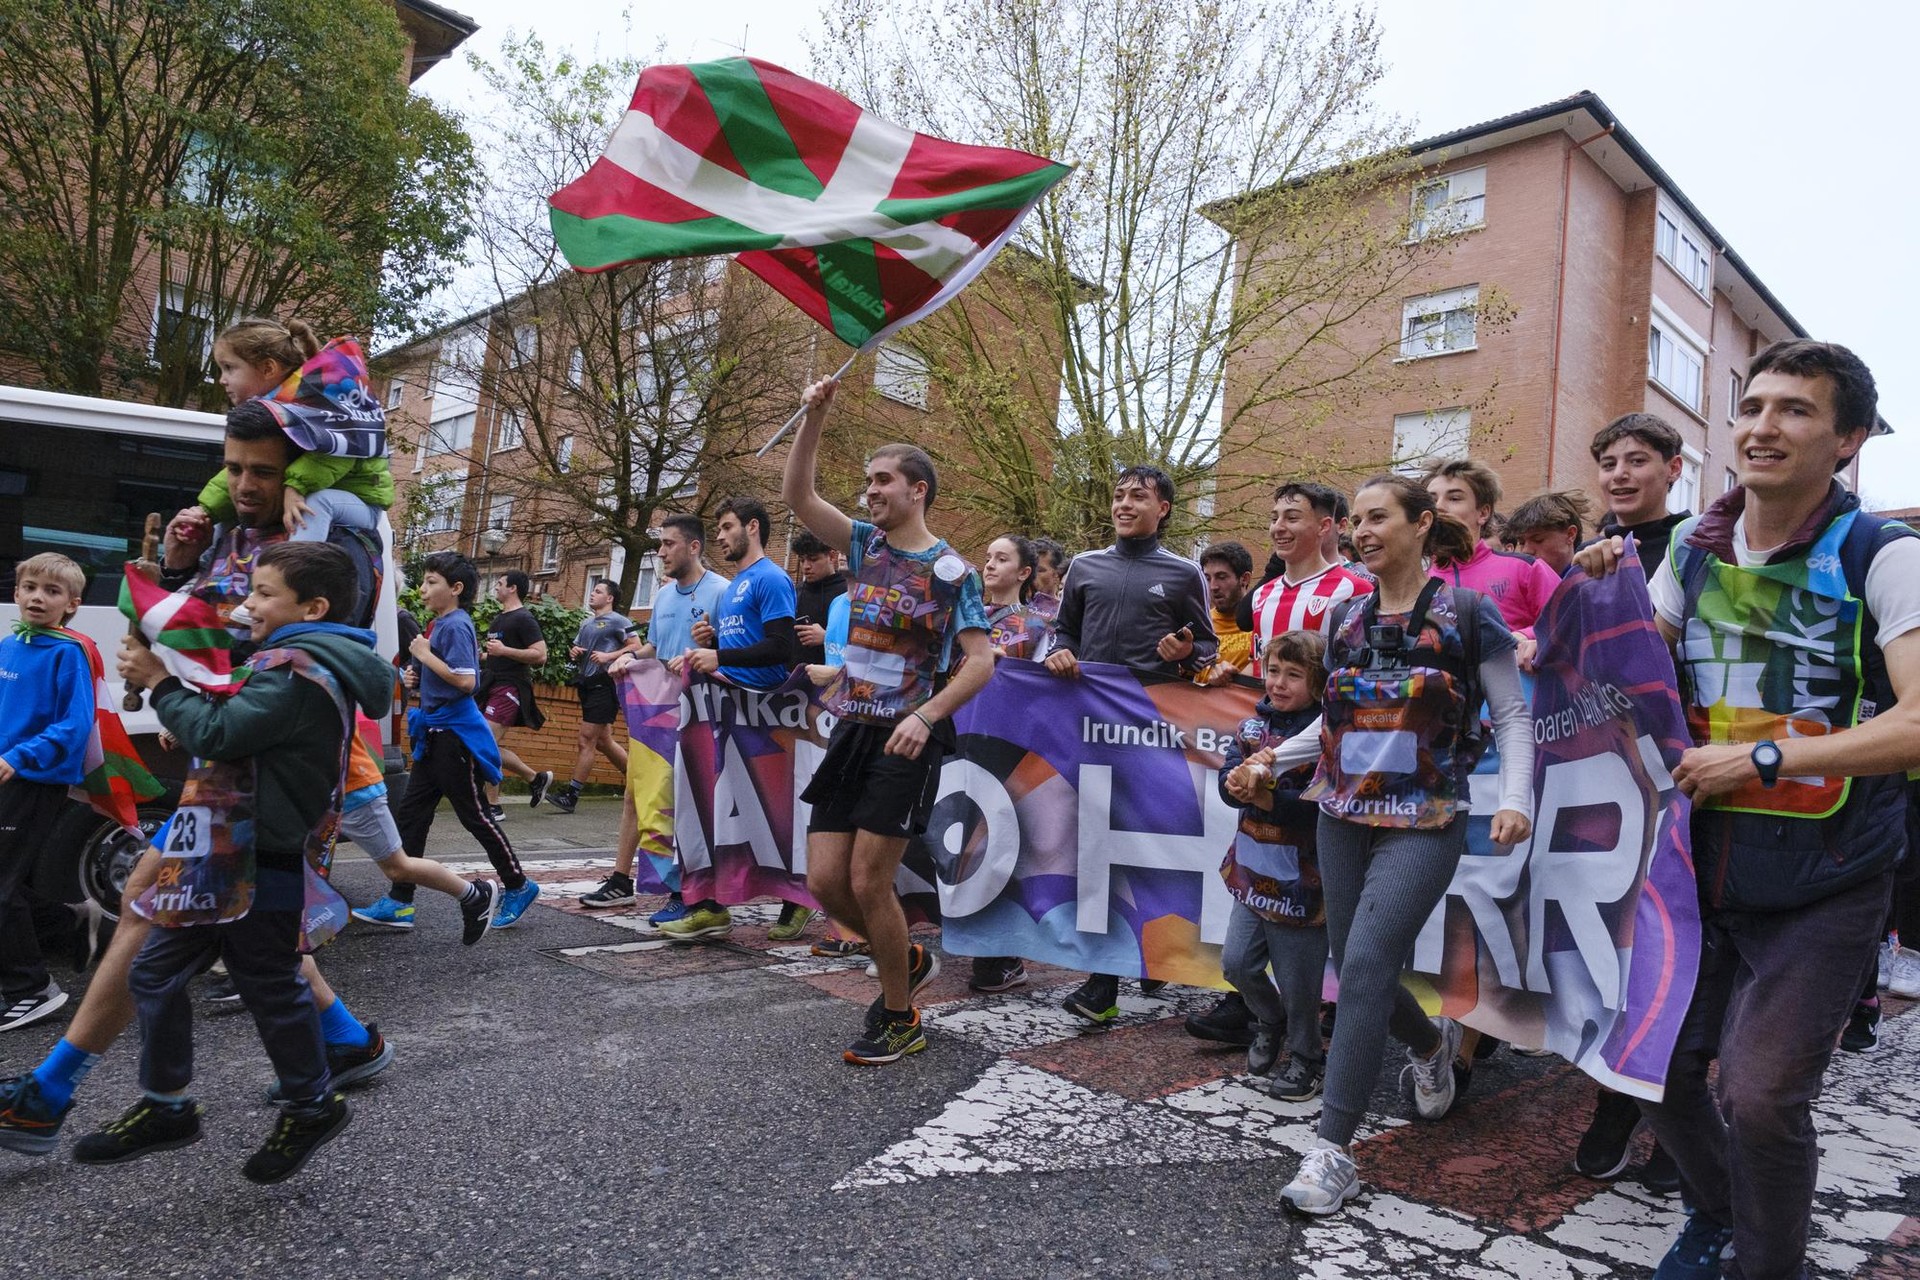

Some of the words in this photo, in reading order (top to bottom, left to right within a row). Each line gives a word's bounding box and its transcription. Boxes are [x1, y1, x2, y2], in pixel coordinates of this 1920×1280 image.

[338, 380, 373, 409] aek
[1806, 552, 1842, 578] aek
[853, 630, 891, 647] euskaltel
[676, 682, 809, 731] orrika
[1356, 710, 1402, 723] euskaltel
[1083, 716, 1187, 749] Irundik
[1196, 728, 1235, 755] Ba
[1534, 707, 1579, 745] oaren
[169, 811, 196, 852] 23
[157, 863, 185, 887] ek
